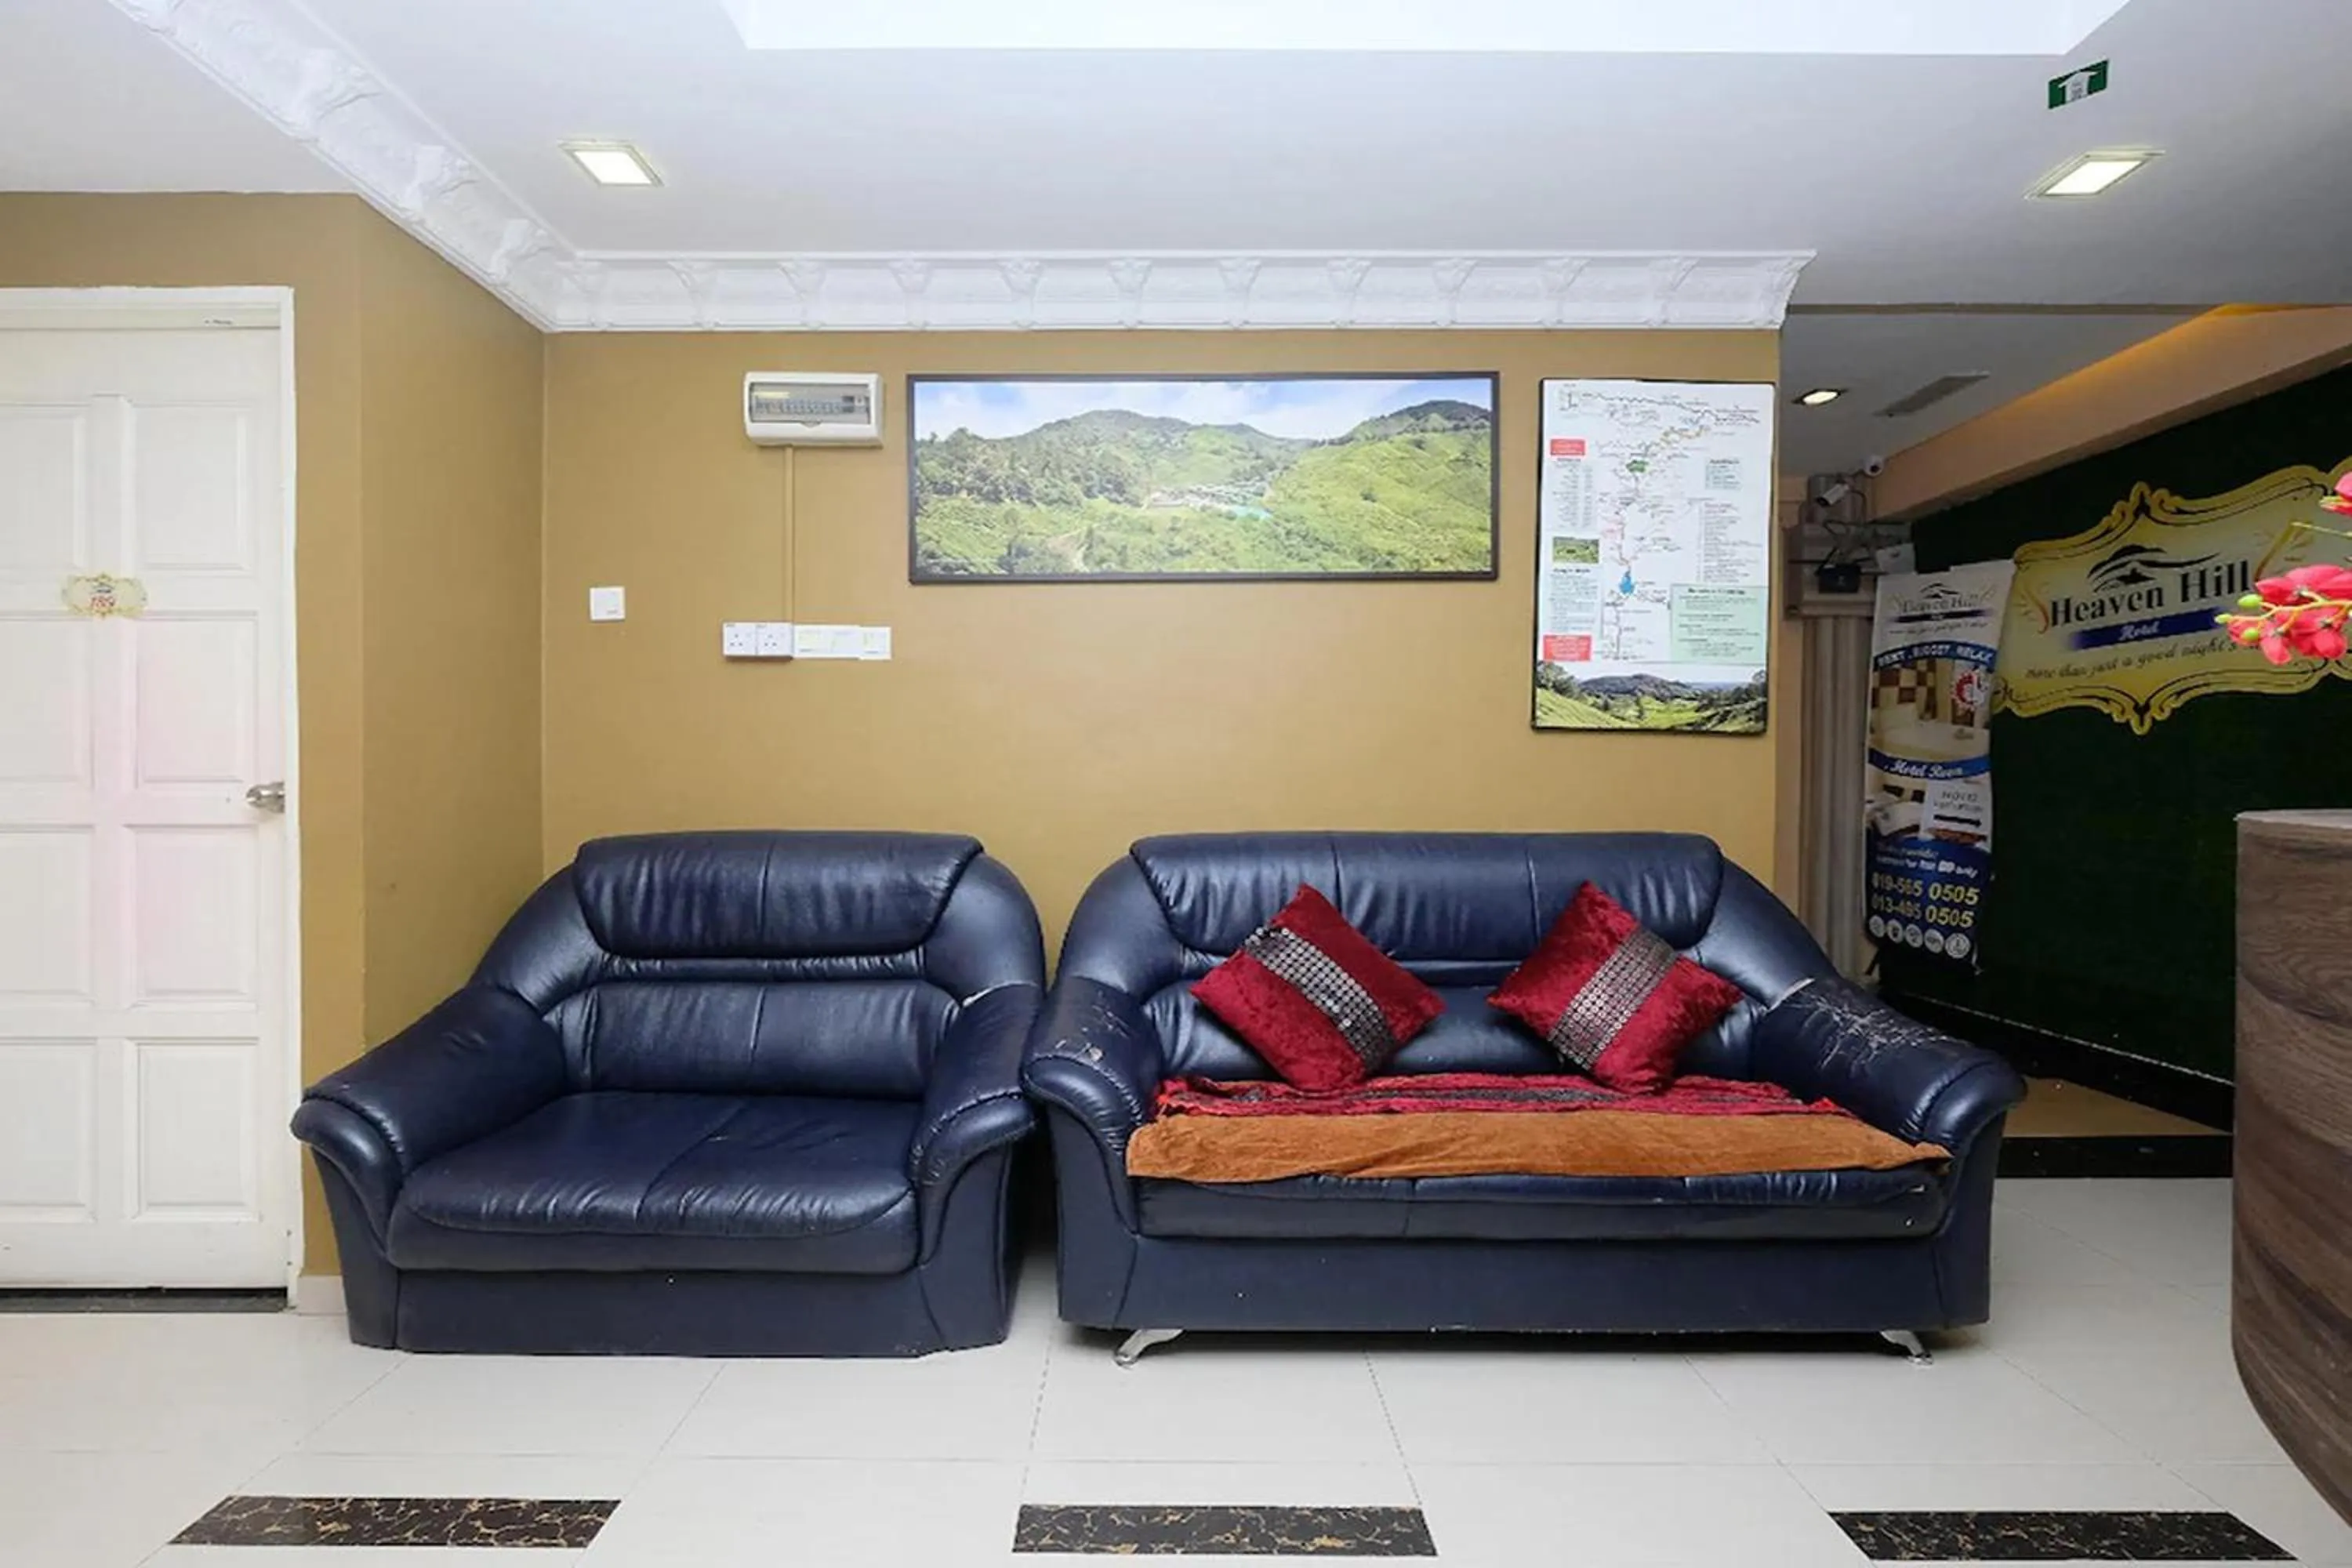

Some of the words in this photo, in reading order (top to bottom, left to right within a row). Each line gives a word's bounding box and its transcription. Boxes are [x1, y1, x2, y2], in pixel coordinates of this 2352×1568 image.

[2049, 586, 2164, 627] Heaven
[2180, 560, 2251, 603] Hill
[2137, 648, 2176, 670] good
[1928, 881, 1980, 906] 0505
[1925, 904, 1976, 928] 0505
